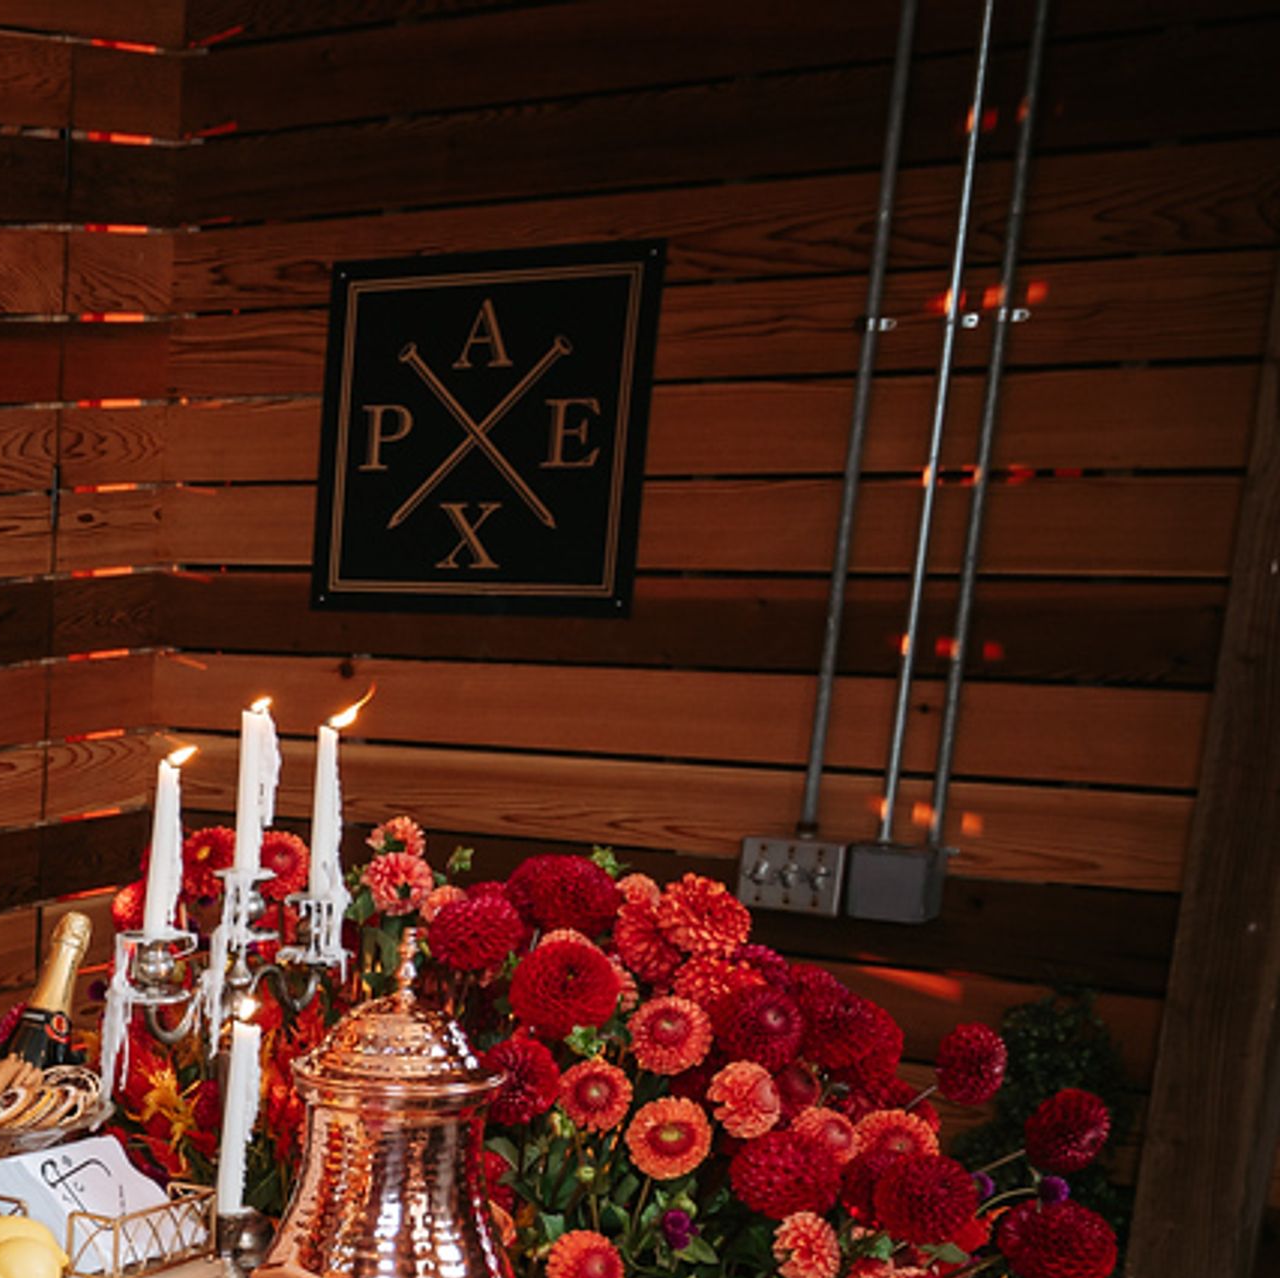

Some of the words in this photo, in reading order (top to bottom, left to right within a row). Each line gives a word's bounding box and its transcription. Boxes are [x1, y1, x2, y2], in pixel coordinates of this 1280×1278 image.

[452, 299, 513, 369] A
[358, 405, 414, 471] P
[540, 398, 601, 468] E
[435, 503, 503, 569] X
